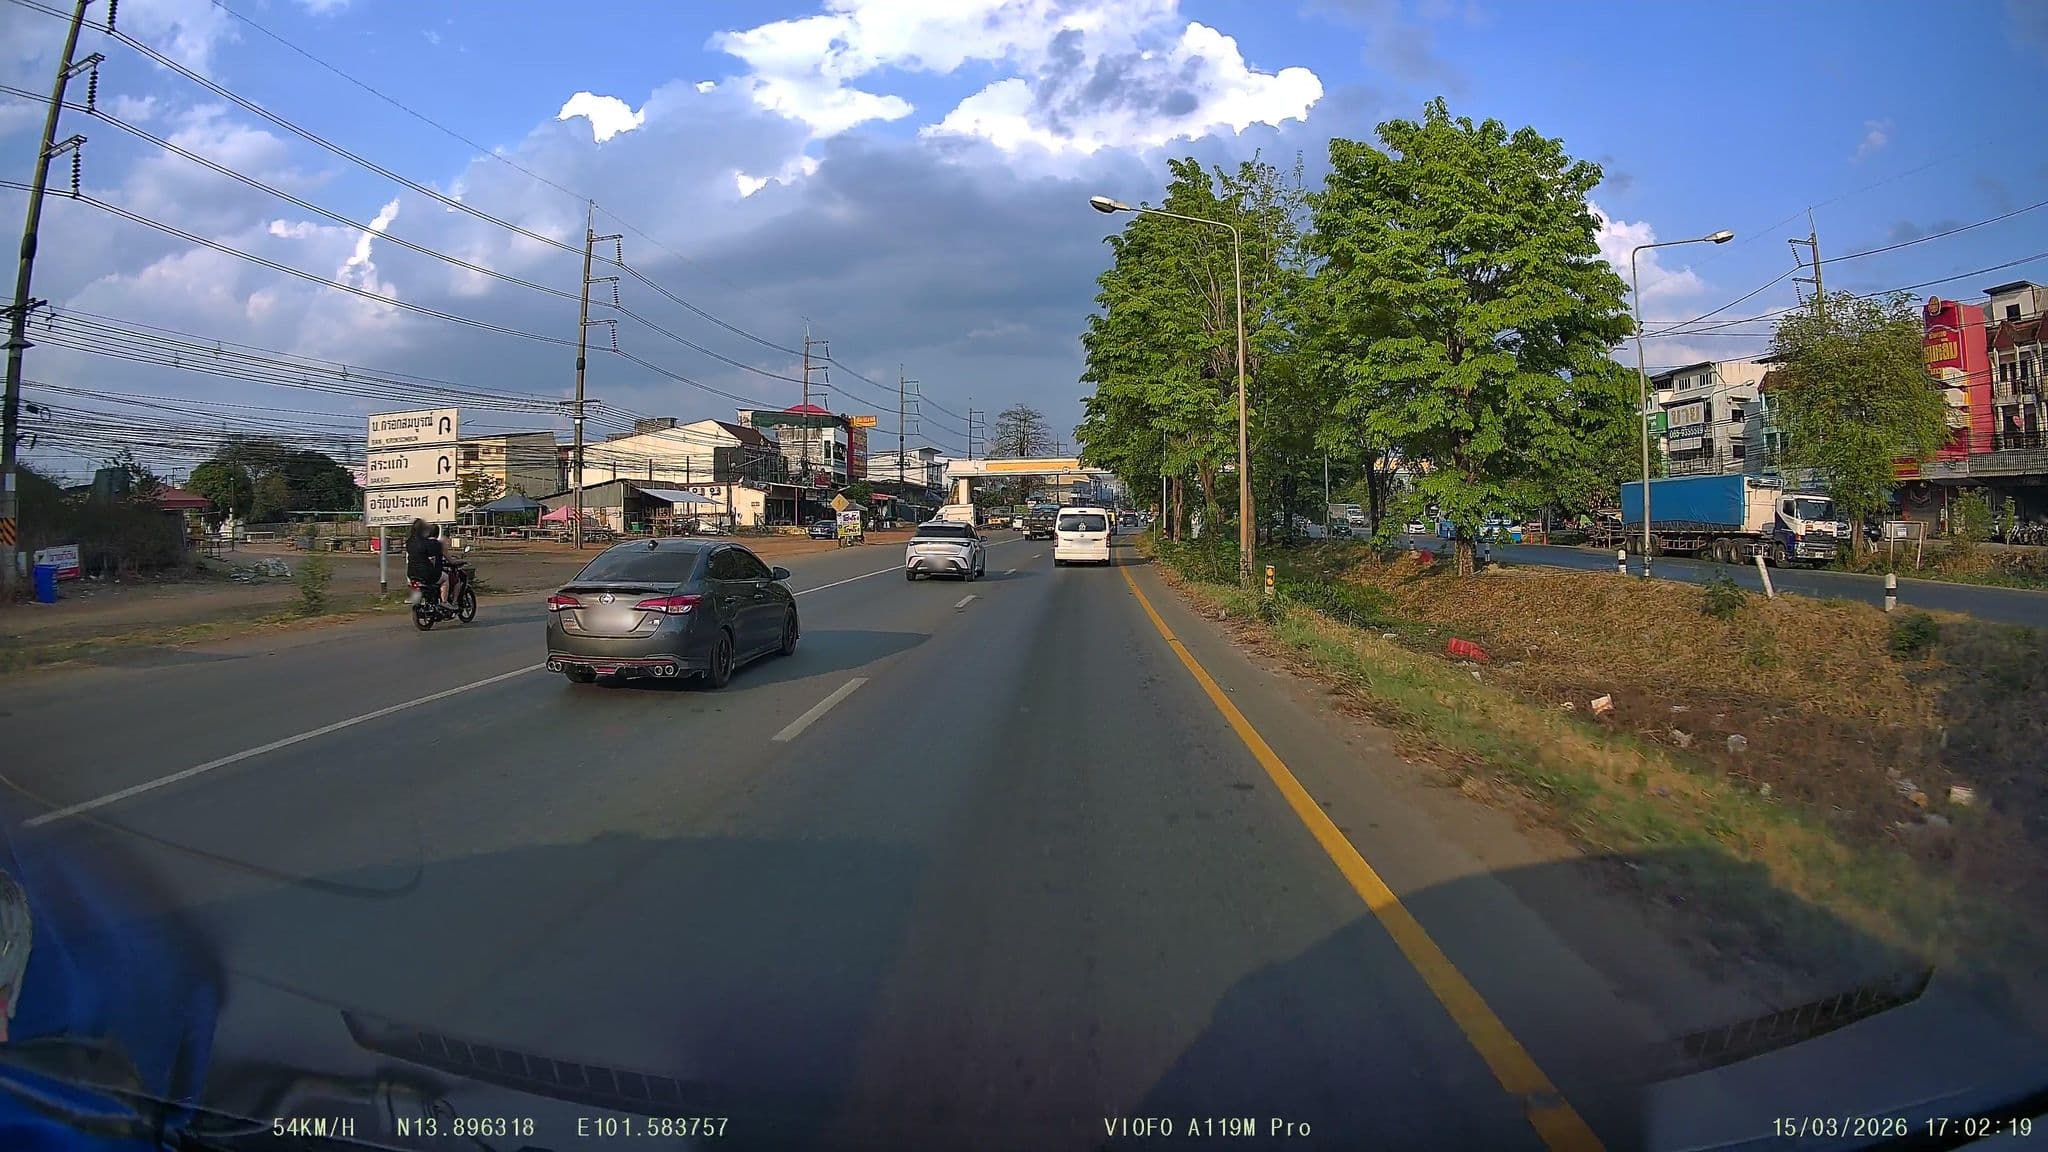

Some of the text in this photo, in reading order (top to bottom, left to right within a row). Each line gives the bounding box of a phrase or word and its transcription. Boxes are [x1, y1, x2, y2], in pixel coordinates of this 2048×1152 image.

[1671, 406, 1700, 425] ขาย
[370, 454, 409, 471] สระแก้ว
[370, 494, 429, 513] อรัญประเทศ
